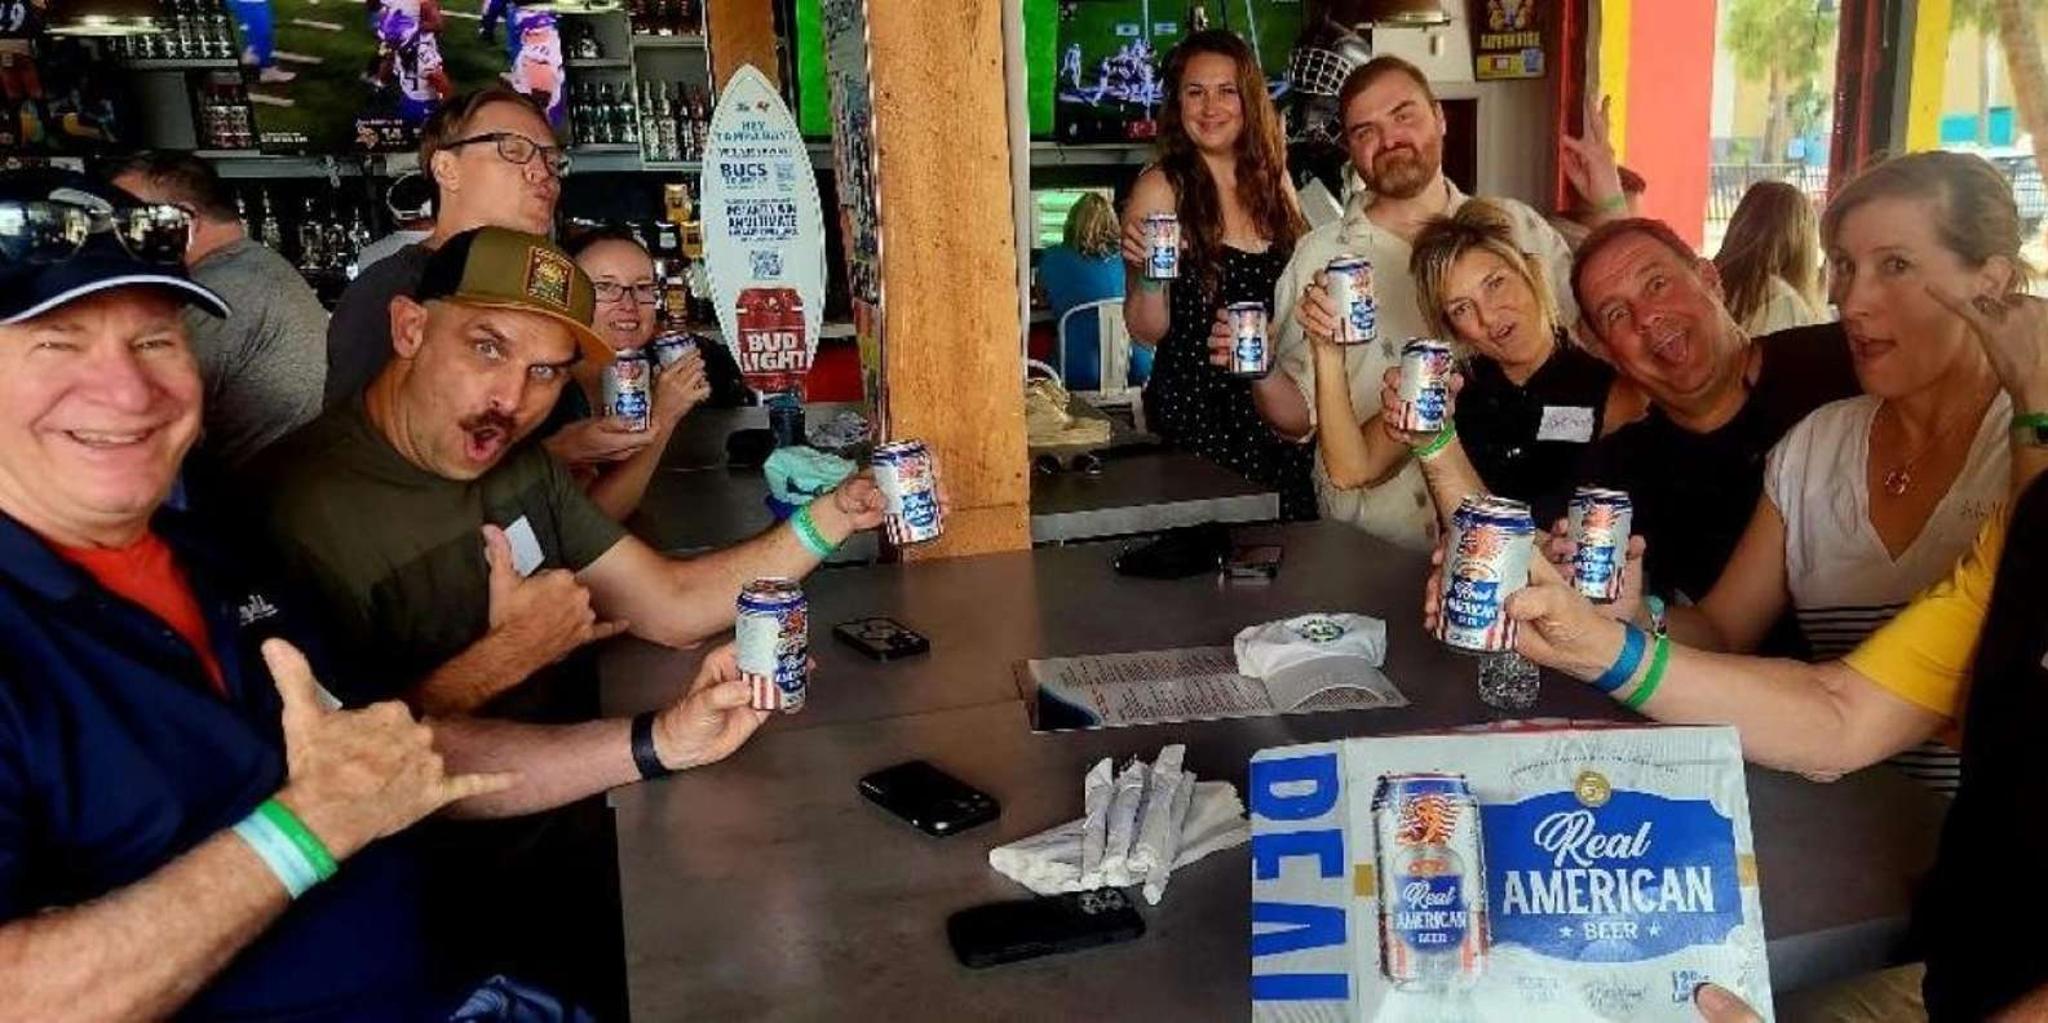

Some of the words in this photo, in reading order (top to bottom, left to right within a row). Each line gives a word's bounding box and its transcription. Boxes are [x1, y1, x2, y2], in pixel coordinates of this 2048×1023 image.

[720, 163, 768, 177] BUCS
[748, 332, 798, 351] BUD
[742, 351, 806, 372] LIGHT
[1534, 809, 1653, 867] Real
[1403, 880, 1456, 910] Real
[1503, 866, 1716, 915] AMERICAN
[1396, 910, 1467, 930] AMERICAN
[1583, 921, 1639, 940] BEER
